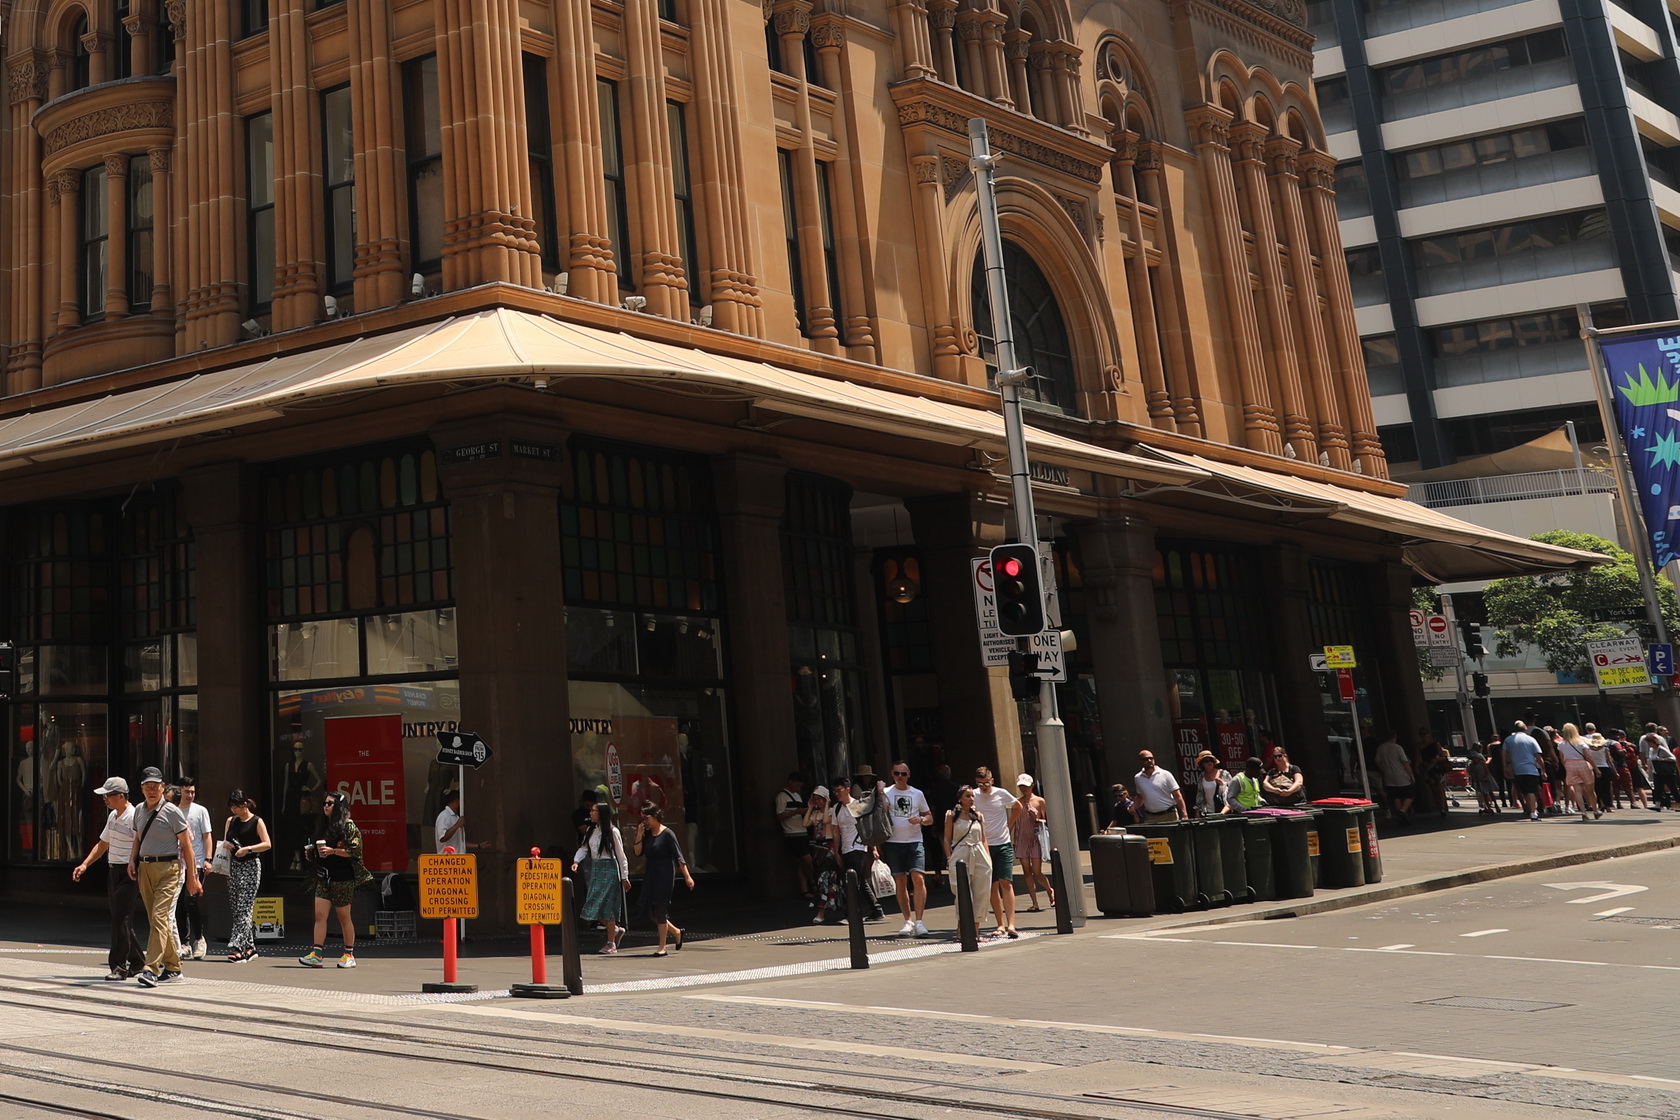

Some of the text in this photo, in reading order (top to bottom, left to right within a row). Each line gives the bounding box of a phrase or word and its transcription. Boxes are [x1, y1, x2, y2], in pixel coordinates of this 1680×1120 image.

[456, 443, 499, 457] GEORGE ST
[514, 444, 551, 457] MARKET ST
[1034, 636, 1056, 647] ONE
[1590, 640, 1635, 649] CLEARWAY
[1036, 652, 1059, 662] WAY
[1656, 652, 1666, 662] P
[402, 720, 447, 739] UNTRY
[1180, 729, 1199, 742] IT'S
[1178, 743, 1203, 757] YOUR
[1228, 747, 1242, 759] OFF
[475, 751, 485, 761] $15
[1184, 757, 1202, 771] CU
[337, 780, 396, 806] SALE
[429, 858, 466, 866] CHANGED
[524, 893, 555, 901] DIAGONAL
[423, 907, 476, 915] NOT PERMITTED
[524, 903, 555, 911] CROSSING
[519, 913, 560, 921] NOT PERMITTED
